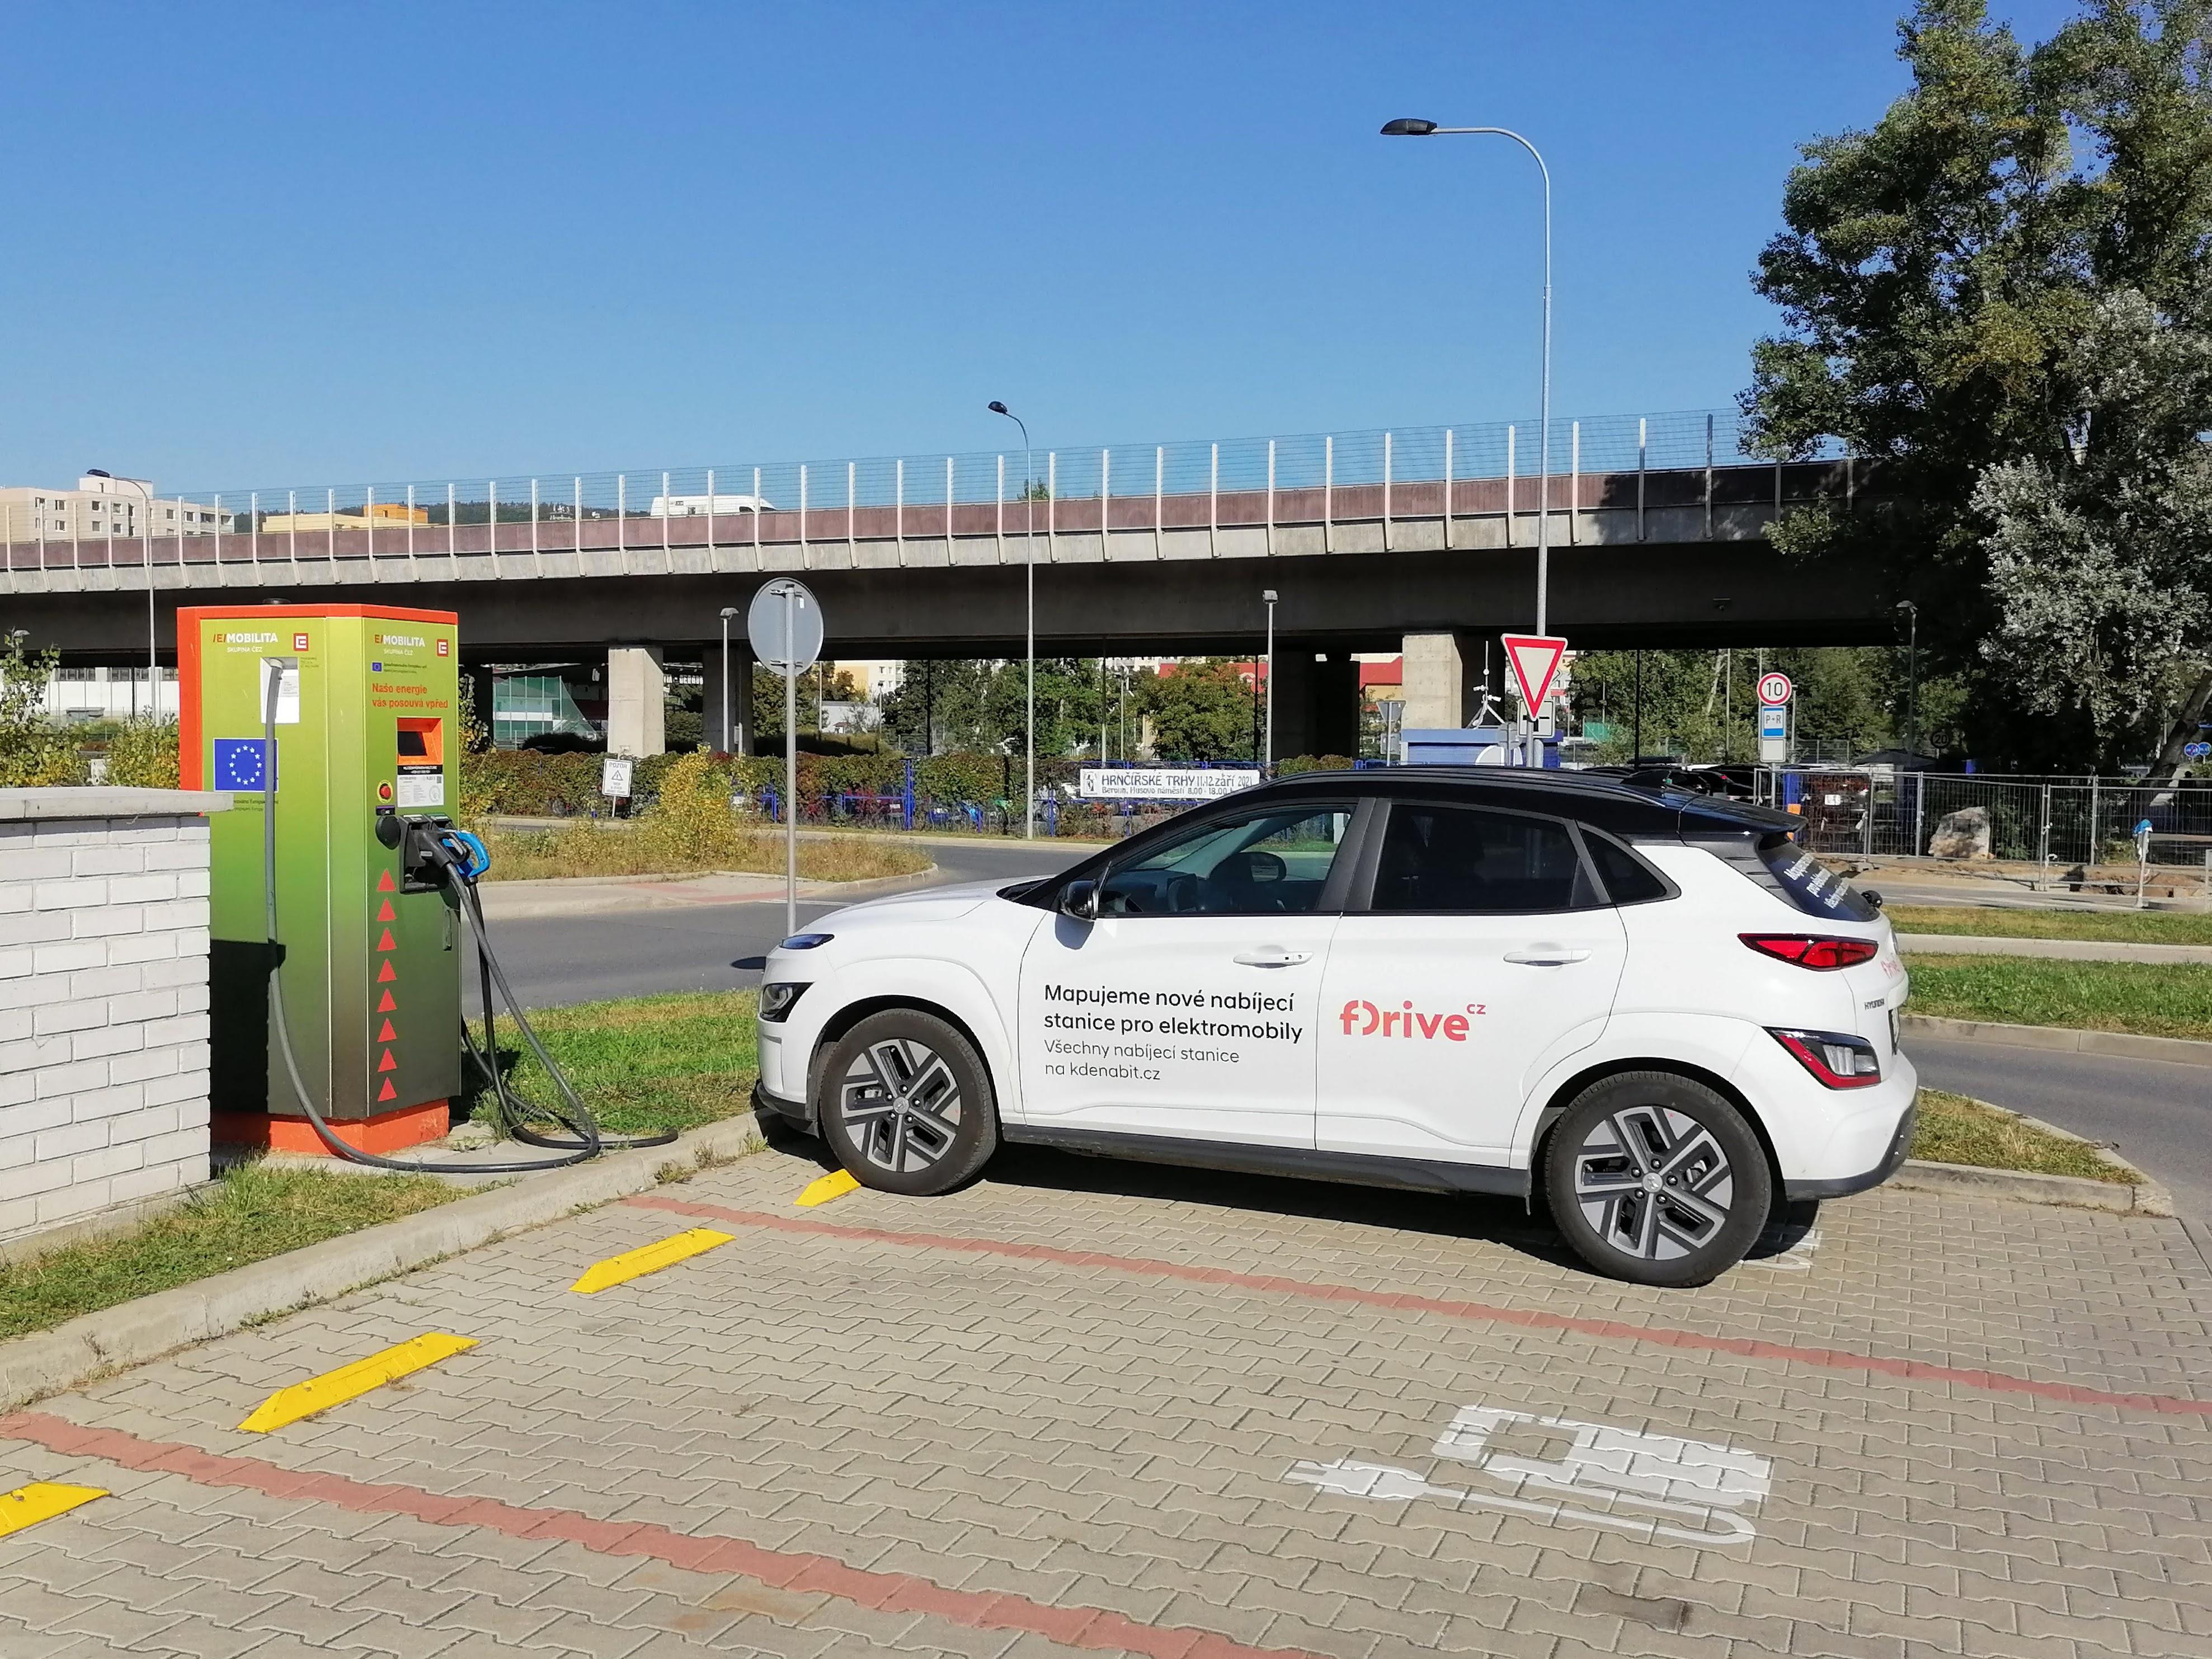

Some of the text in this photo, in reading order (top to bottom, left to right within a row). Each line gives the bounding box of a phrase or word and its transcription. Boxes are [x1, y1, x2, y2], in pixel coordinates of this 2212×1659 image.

[252, 645, 263, 653] ČEZ
[396, 684, 428, 695] energie
[1767, 682, 1783, 697] 10
[372, 697, 448, 709] vás posouvá vpřed
[1766, 715, 1782, 724] P+R
[1935, 734, 1947, 744] 20
[1102, 772, 1163, 786] HRNČÍŘSKÉ
[1165, 775, 1196, 787] TRHY
[1237, 776, 1253, 788] 2021
[1044, 985, 1295, 1014] Mapujeme nové nabíjecí
[1044, 1012, 1303, 1044] stanice pro elektromobily
[1044, 1038, 1240, 1063] Všechny nabíjecí stanice
[1044, 1061, 1161, 1080] na kdenabit.cz
